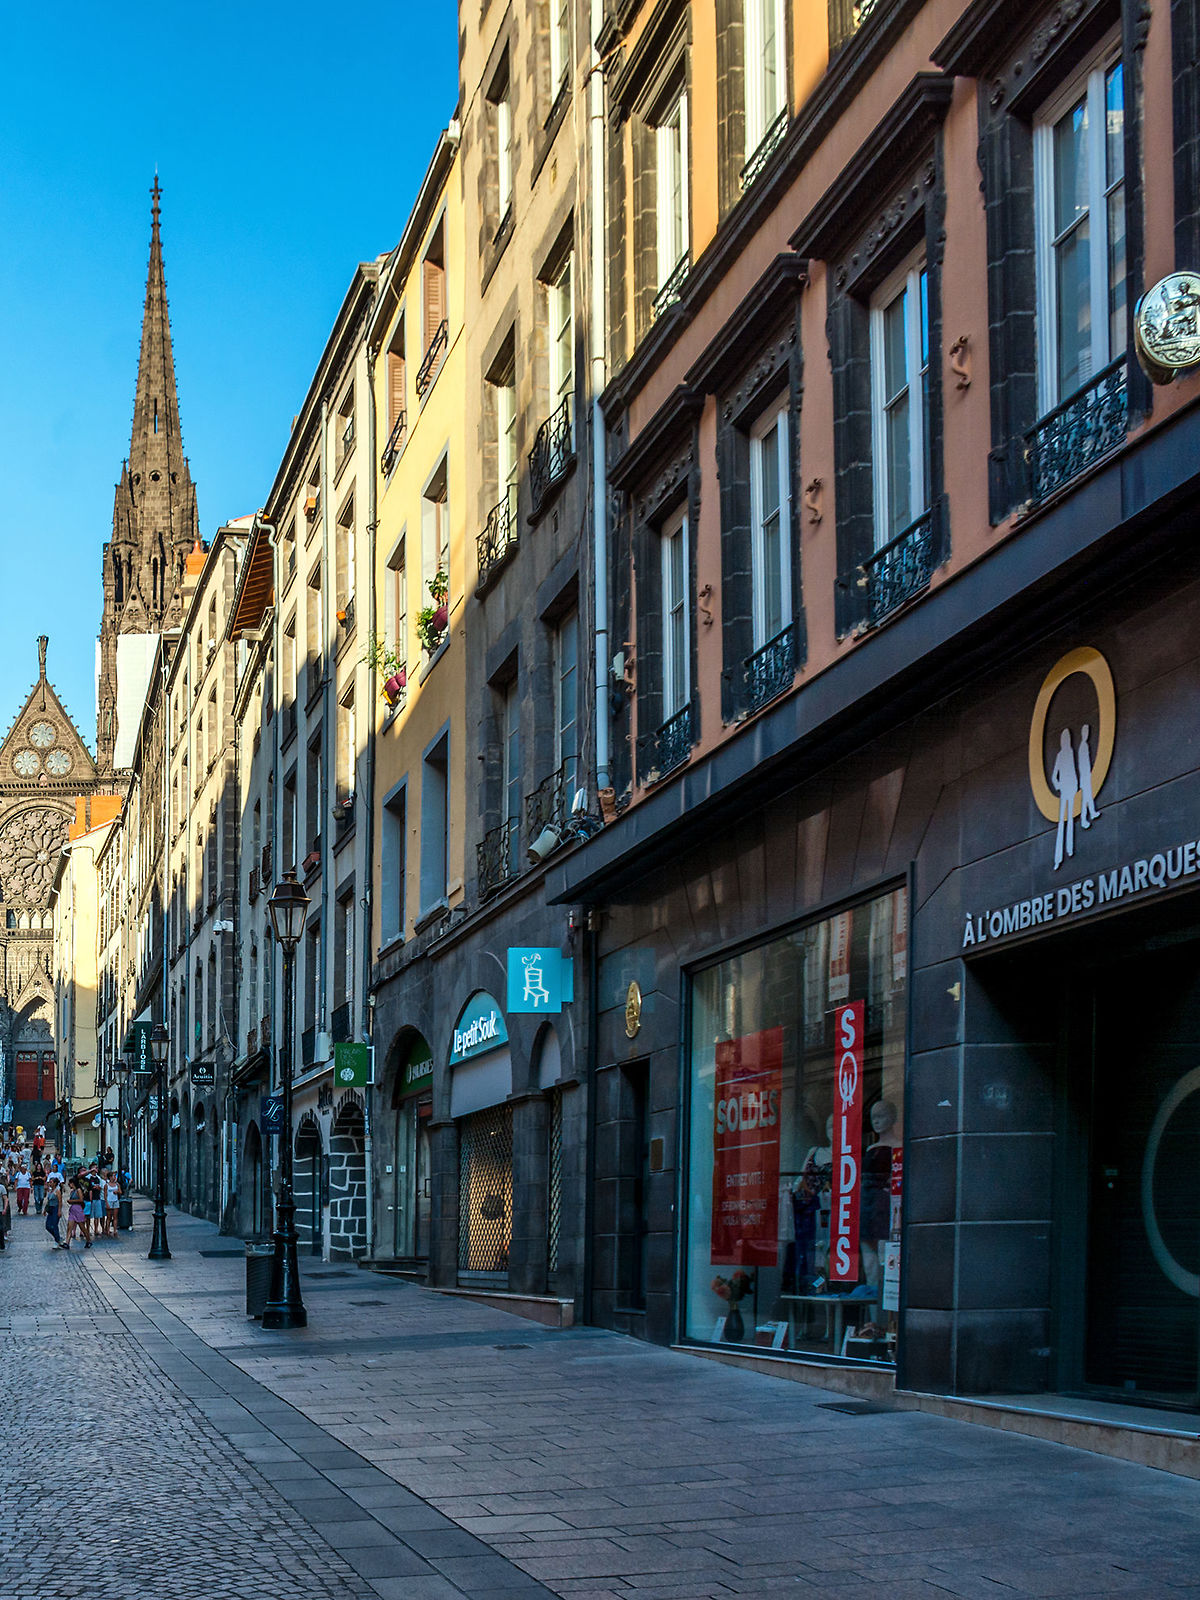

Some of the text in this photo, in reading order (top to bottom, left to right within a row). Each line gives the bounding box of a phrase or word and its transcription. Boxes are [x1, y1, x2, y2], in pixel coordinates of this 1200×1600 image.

[962, 912, 976, 948] À
[977, 893, 1054, 943] L'OMBRE
[1057, 879, 1095, 918] DES
[716, 1089, 778, 1135] SOLDES
